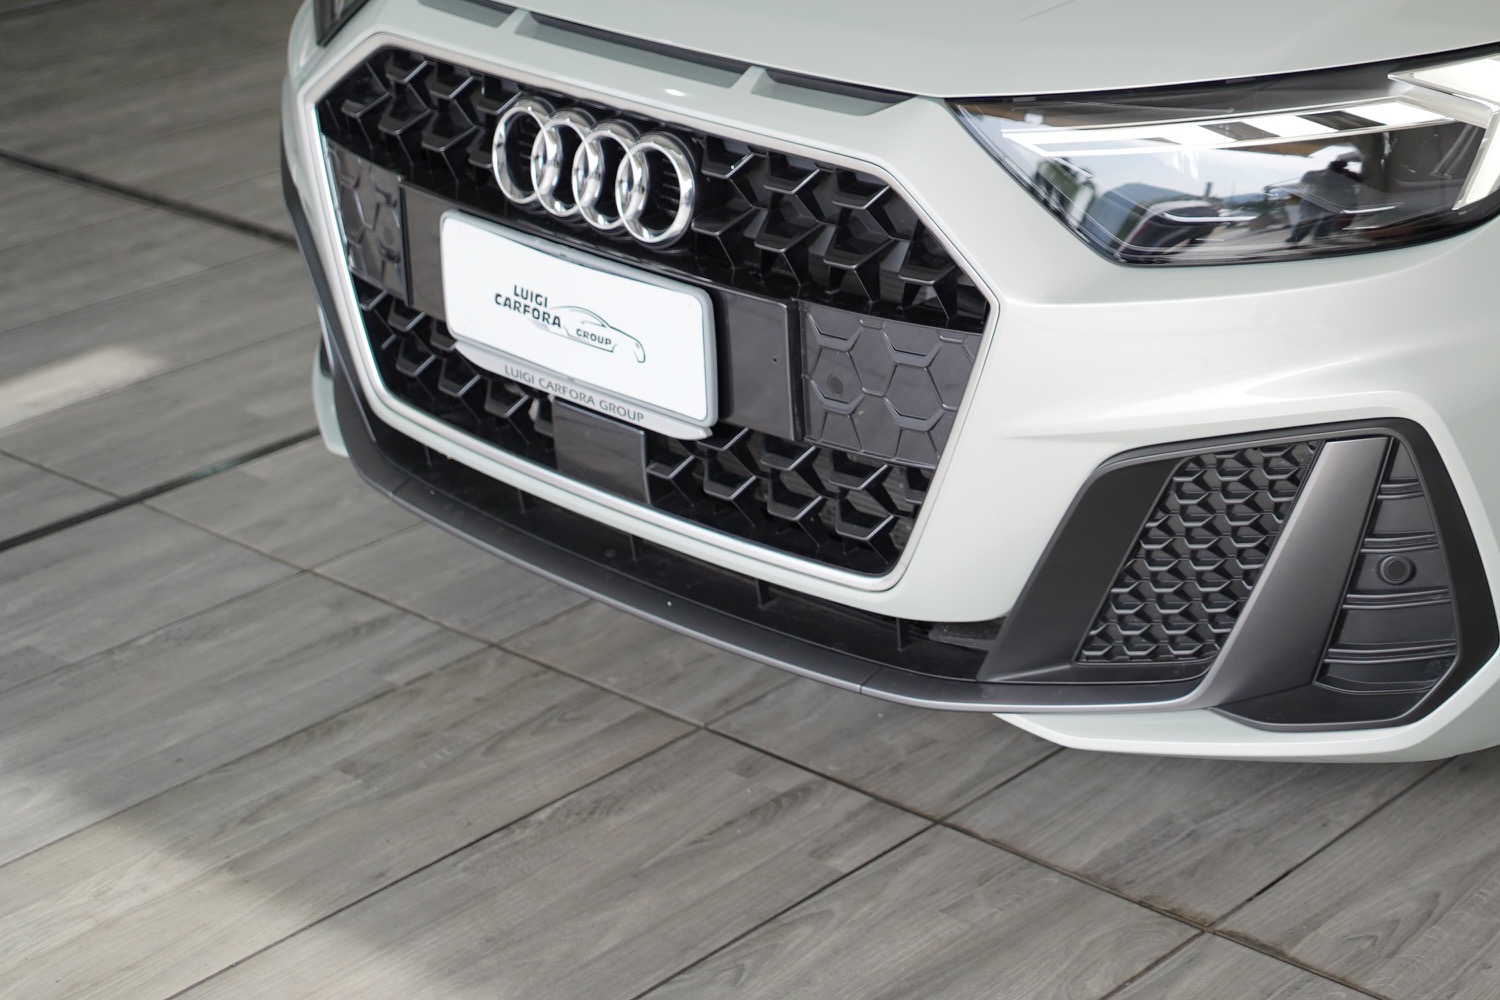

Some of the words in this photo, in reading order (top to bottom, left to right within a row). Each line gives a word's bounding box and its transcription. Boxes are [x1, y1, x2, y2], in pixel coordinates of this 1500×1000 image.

[494, 293, 562, 329] CARFORA
[513, 284, 548, 308] LUIGI
[575, 328, 612, 346] GROUP
[504, 364, 535, 385] LUIGI
[538, 377, 596, 406] CARFORA
[599, 400, 645, 422] GROUP
